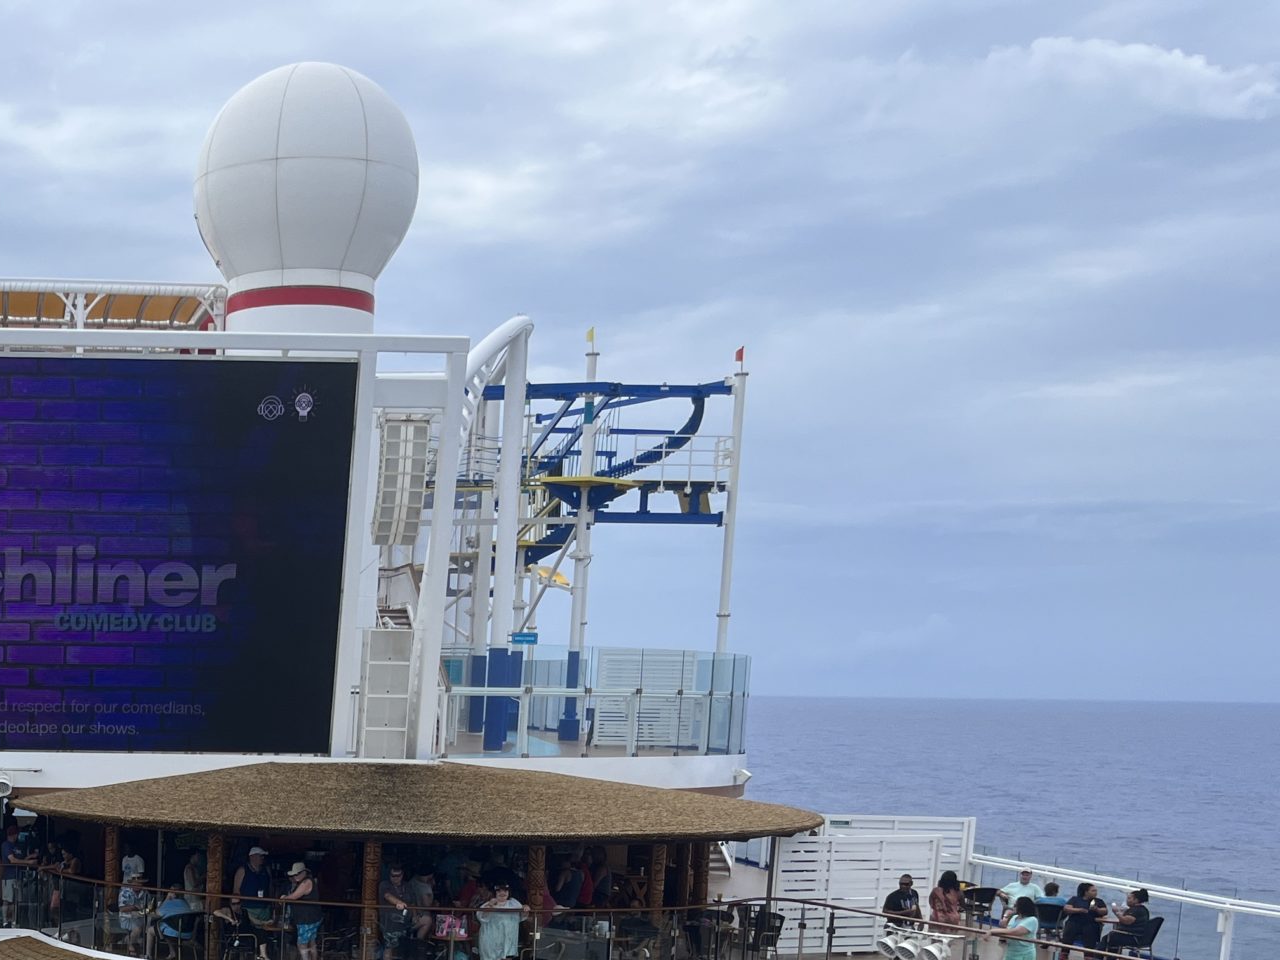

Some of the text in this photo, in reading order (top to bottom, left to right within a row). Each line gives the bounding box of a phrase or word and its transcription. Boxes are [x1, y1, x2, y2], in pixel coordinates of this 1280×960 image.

[54, 612, 216, 633] COMEDY CLUB
[12, 700, 66, 716] respect
[70, 699, 90, 713] for
[94, 702, 118, 714] our
[121, 701, 206, 716] comedians,
[61, 723, 86, 735] our
[89, 722, 140, 736] shows.
